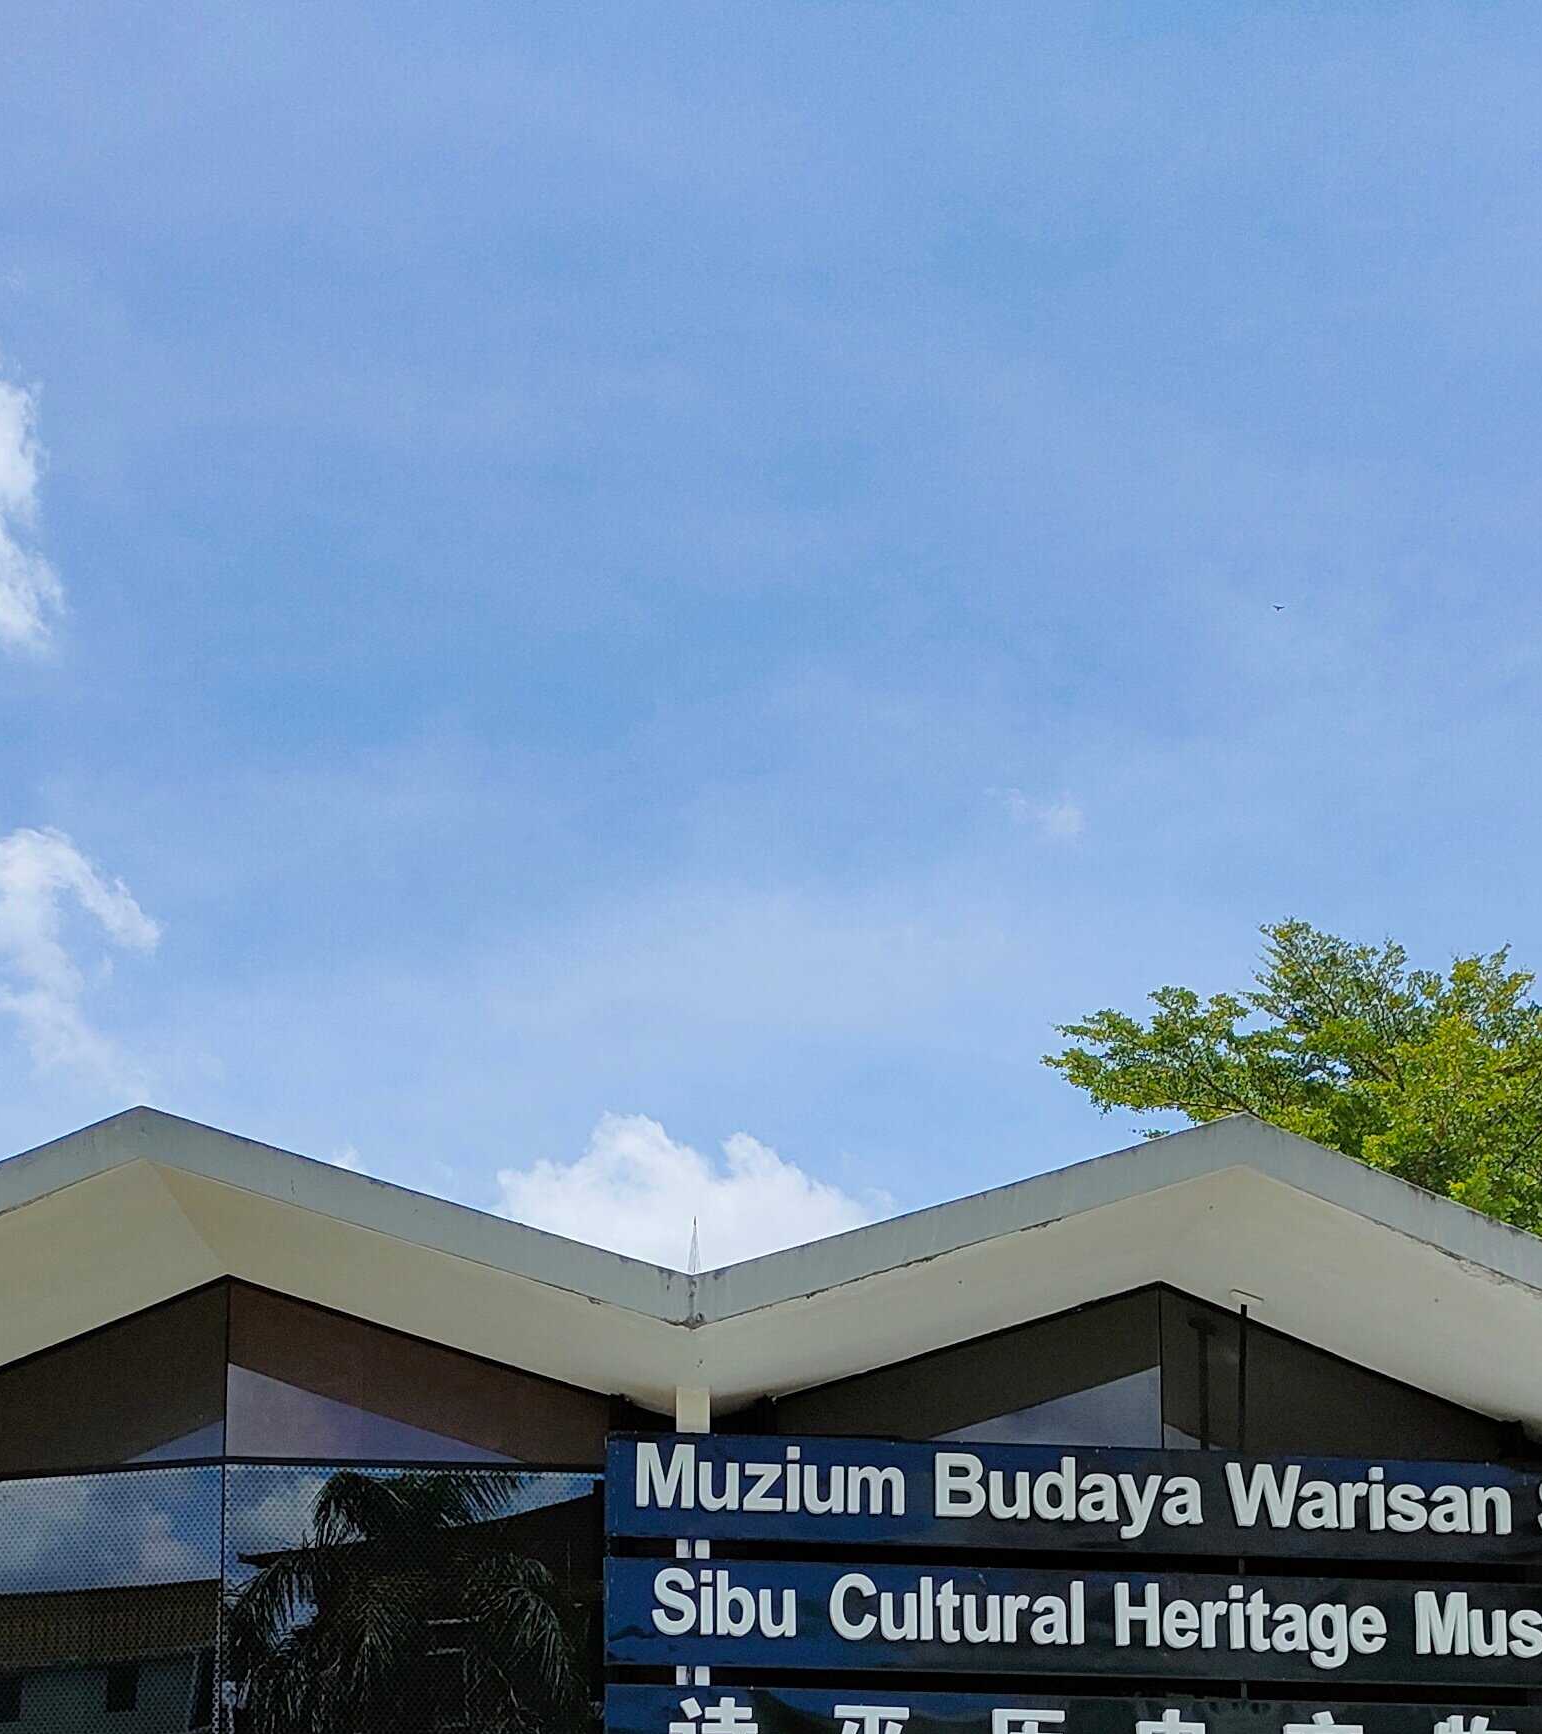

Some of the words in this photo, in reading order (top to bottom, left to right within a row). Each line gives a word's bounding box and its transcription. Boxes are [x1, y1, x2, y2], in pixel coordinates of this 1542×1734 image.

[634, 1441, 906, 1517] Muzium
[934, 1452, 1205, 1540] Budaya
[1225, 1461, 1513, 1535] Warisan
[650, 1566, 798, 1639] Sibu
[828, 1574, 1086, 1646] Cultural
[1113, 1582, 1388, 1670] Heritage
